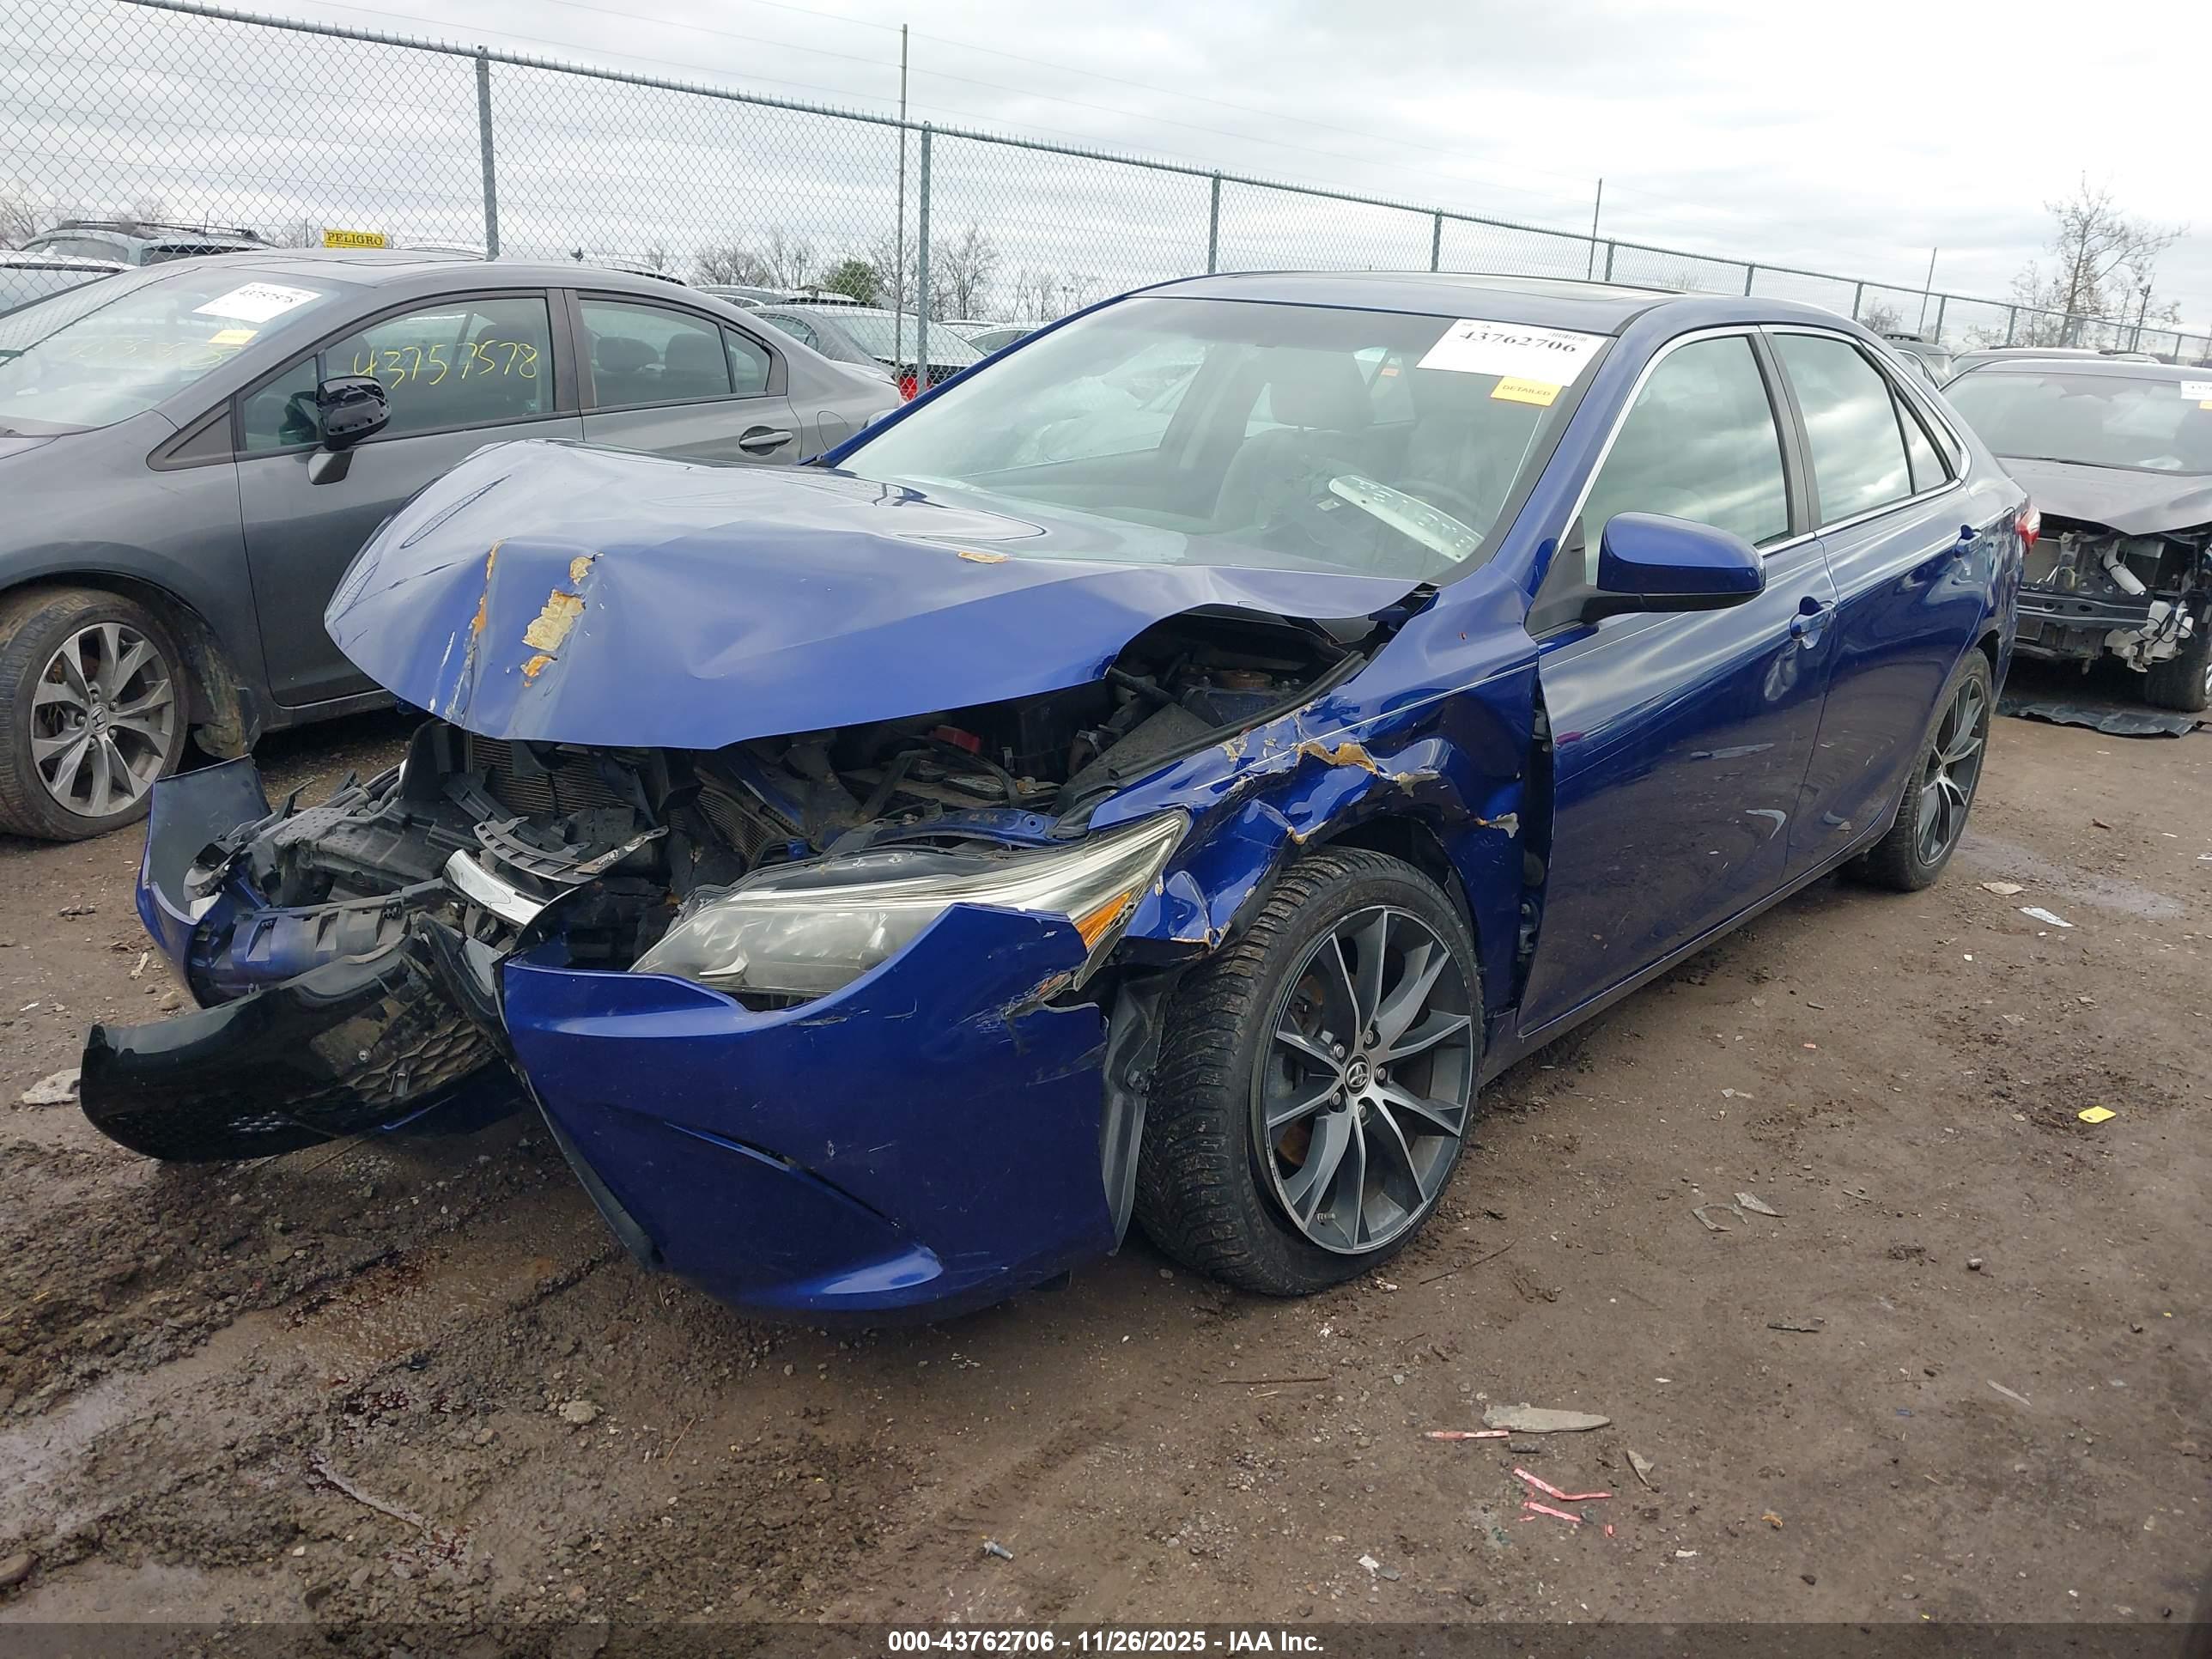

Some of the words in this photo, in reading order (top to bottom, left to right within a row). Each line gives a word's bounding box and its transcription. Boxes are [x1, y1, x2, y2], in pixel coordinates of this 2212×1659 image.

[326, 232, 383, 246] PELIGRO
[1459, 330, 1577, 353] 43762706
[353, 339, 538, 389] 43757578
[1502, 384, 1552, 397] DETAILED
